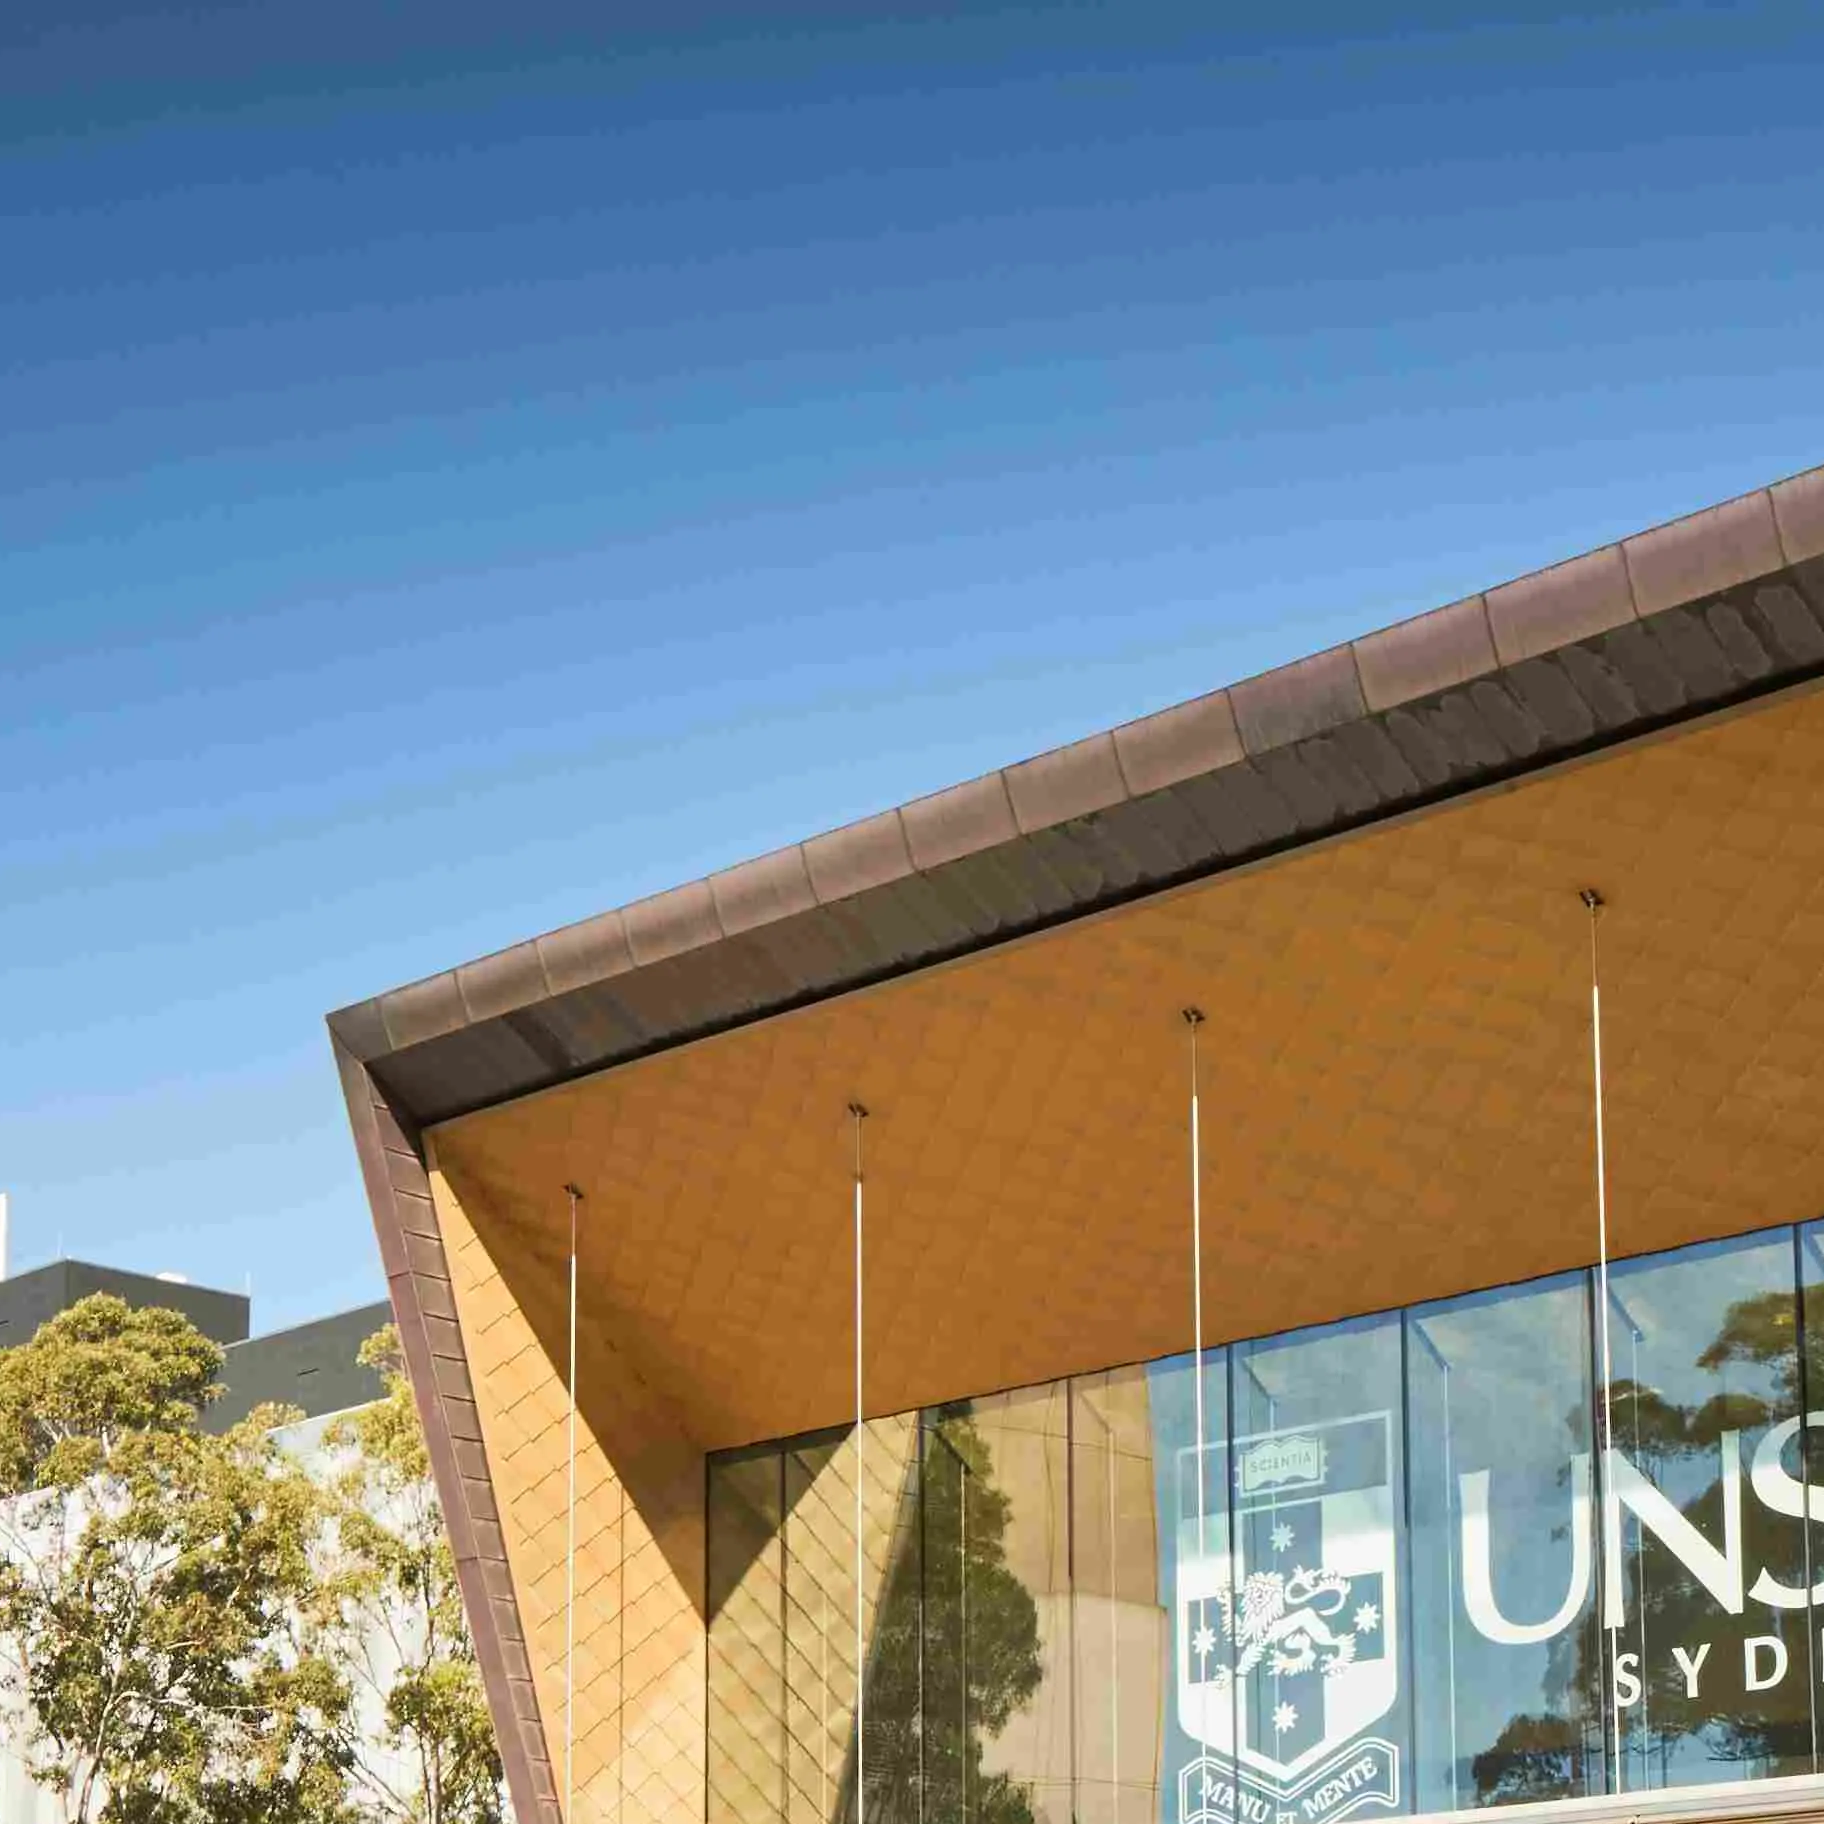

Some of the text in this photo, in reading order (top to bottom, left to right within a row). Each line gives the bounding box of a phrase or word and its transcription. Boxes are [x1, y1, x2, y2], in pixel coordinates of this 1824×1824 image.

[1248, 1451, 1313, 1474] SCIENTIA
[1198, 1774, 1272, 1823] MANU
[1302, 1756, 1379, 1819] MENTE
